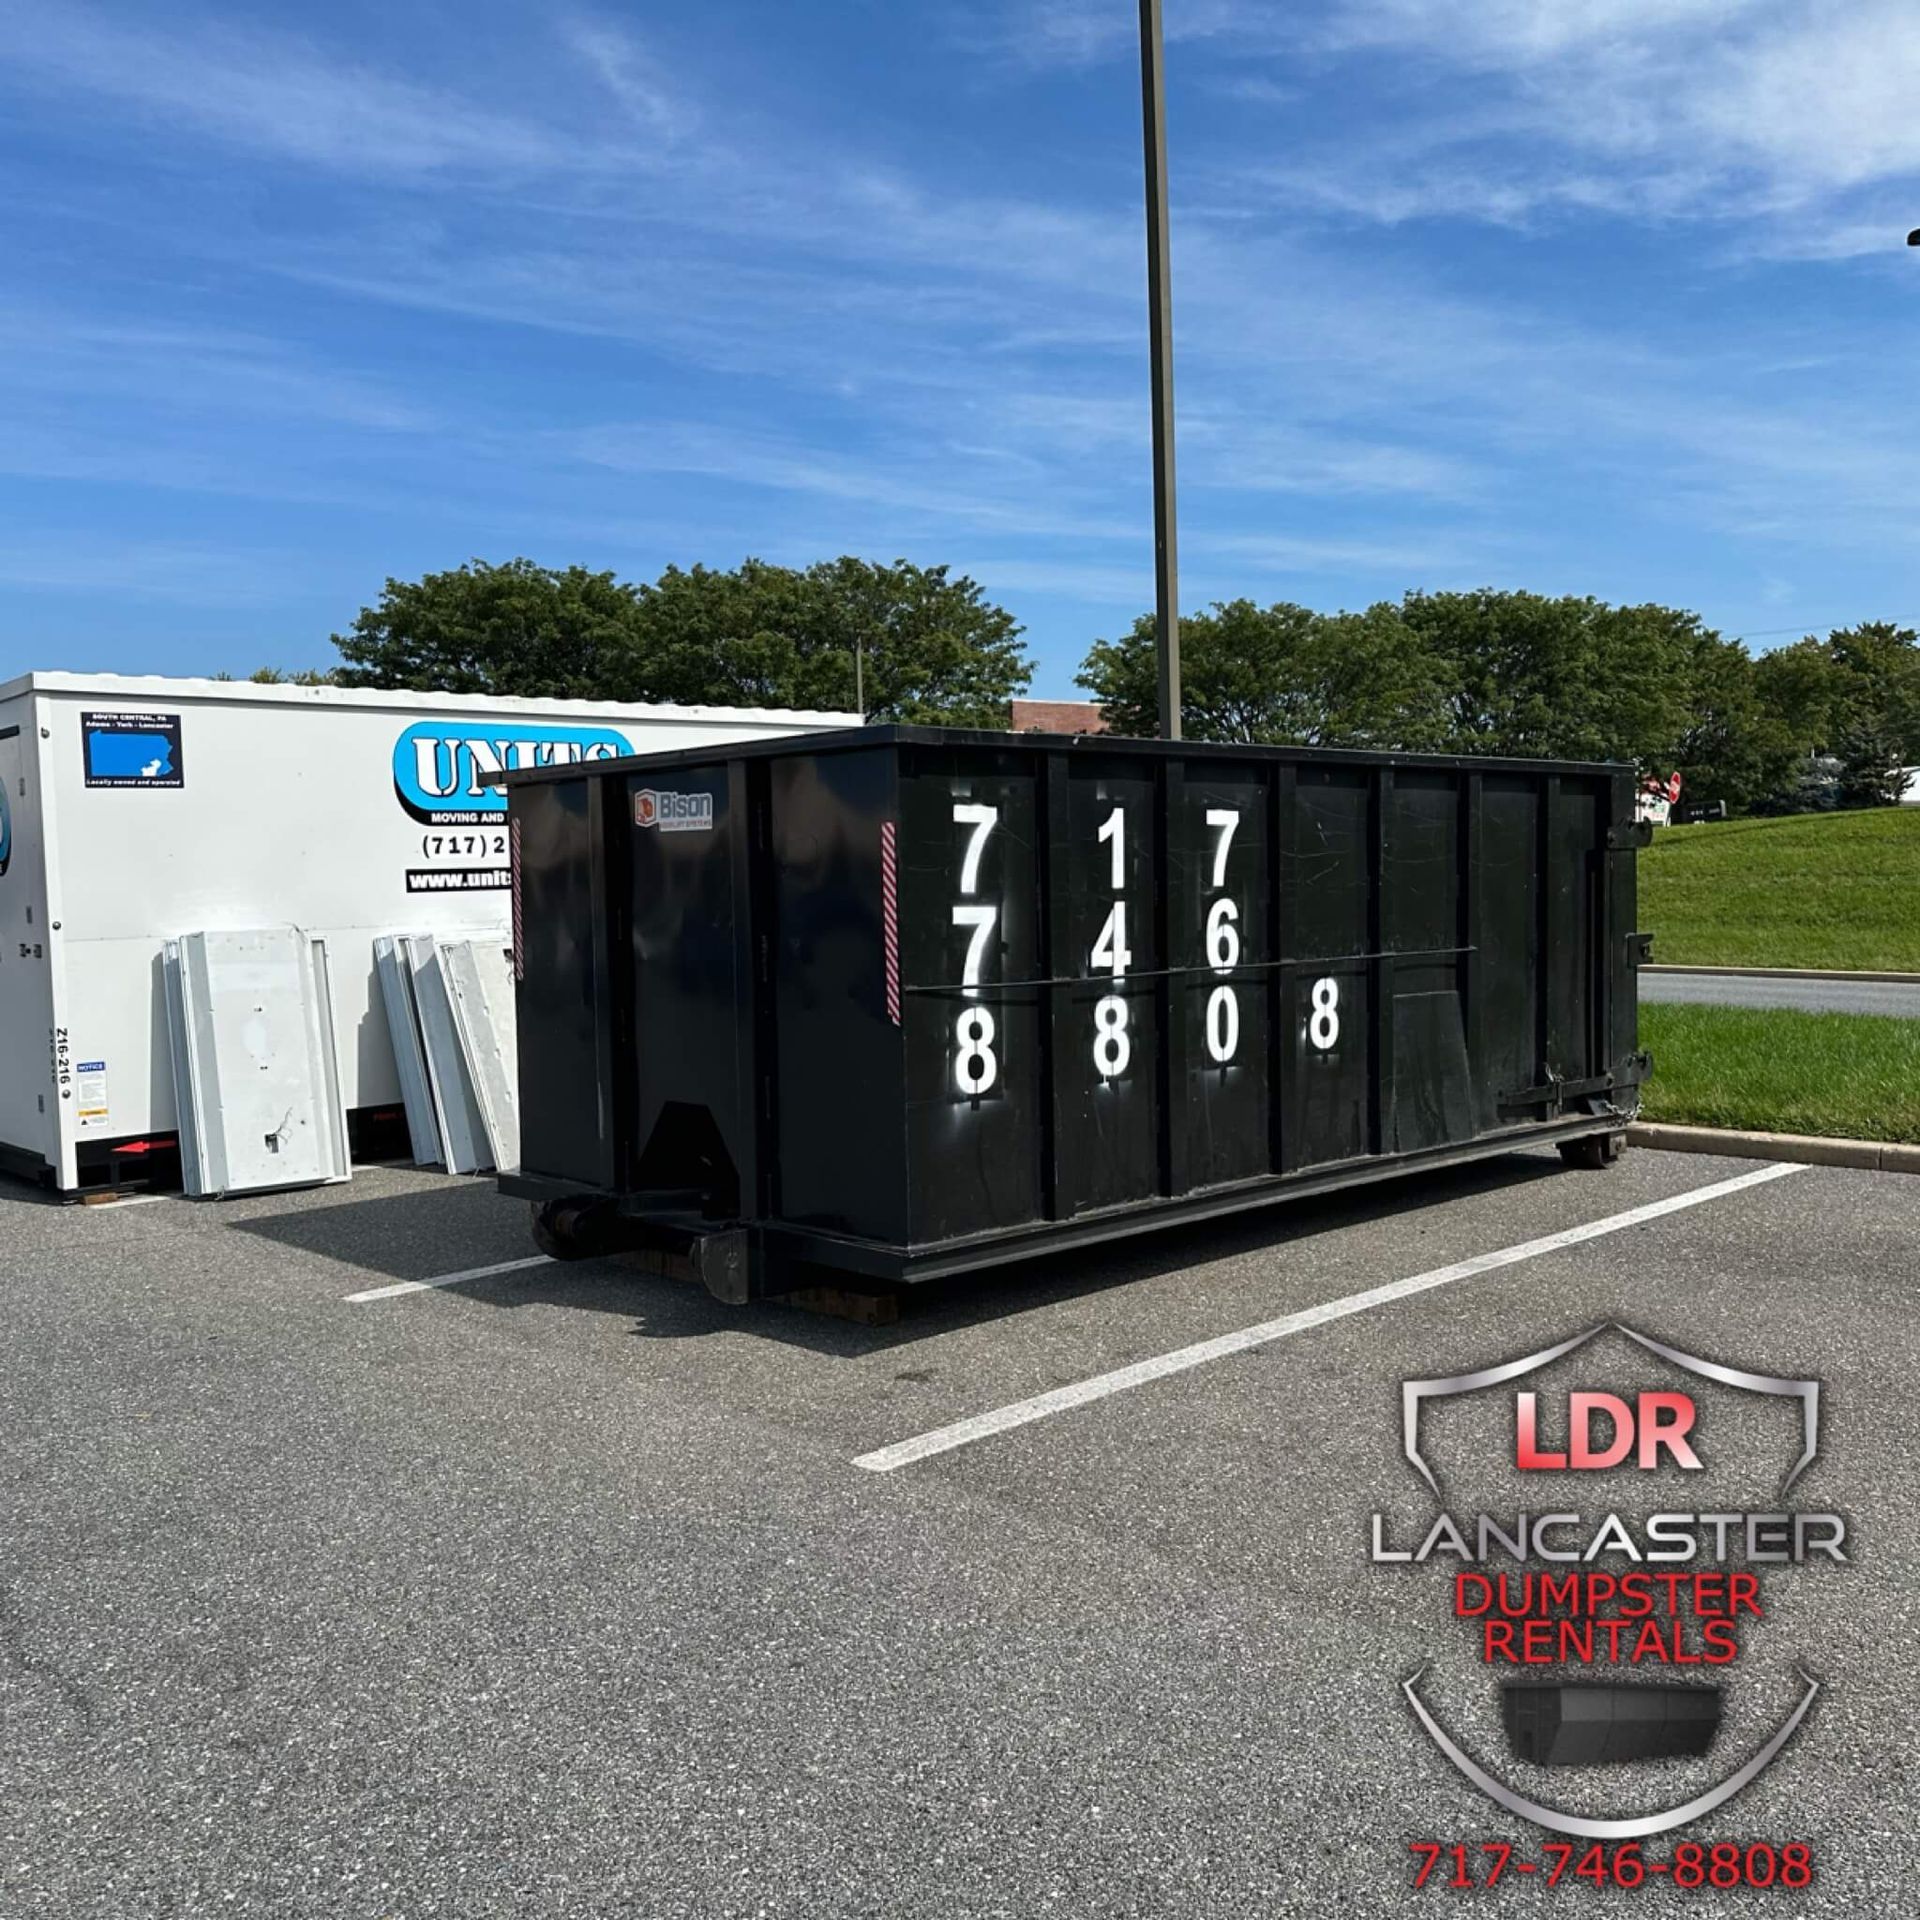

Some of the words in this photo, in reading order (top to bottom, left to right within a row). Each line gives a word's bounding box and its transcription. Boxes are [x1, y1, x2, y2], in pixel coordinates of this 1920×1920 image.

[92, 713, 118, 721] SOUTH
[431, 812, 478, 824] MOVING
[481, 812, 505, 824] AND
[660, 793, 712, 819] Bison
[953, 804, 998, 894] 7
[1098, 807, 1124, 889] 1
[1206, 809, 1239, 887] 7
[409, 870, 512, 889] www.unit
[952, 905, 997, 997] 7
[1091, 901, 1132, 984] 4
[1206, 898, 1239, 975] 6
[955, 1006, 997, 1094] 8
[1093, 995, 1130, 1077] 8
[1206, 985, 1239, 1062] 0
[1310, 977, 1339, 1049] 8
